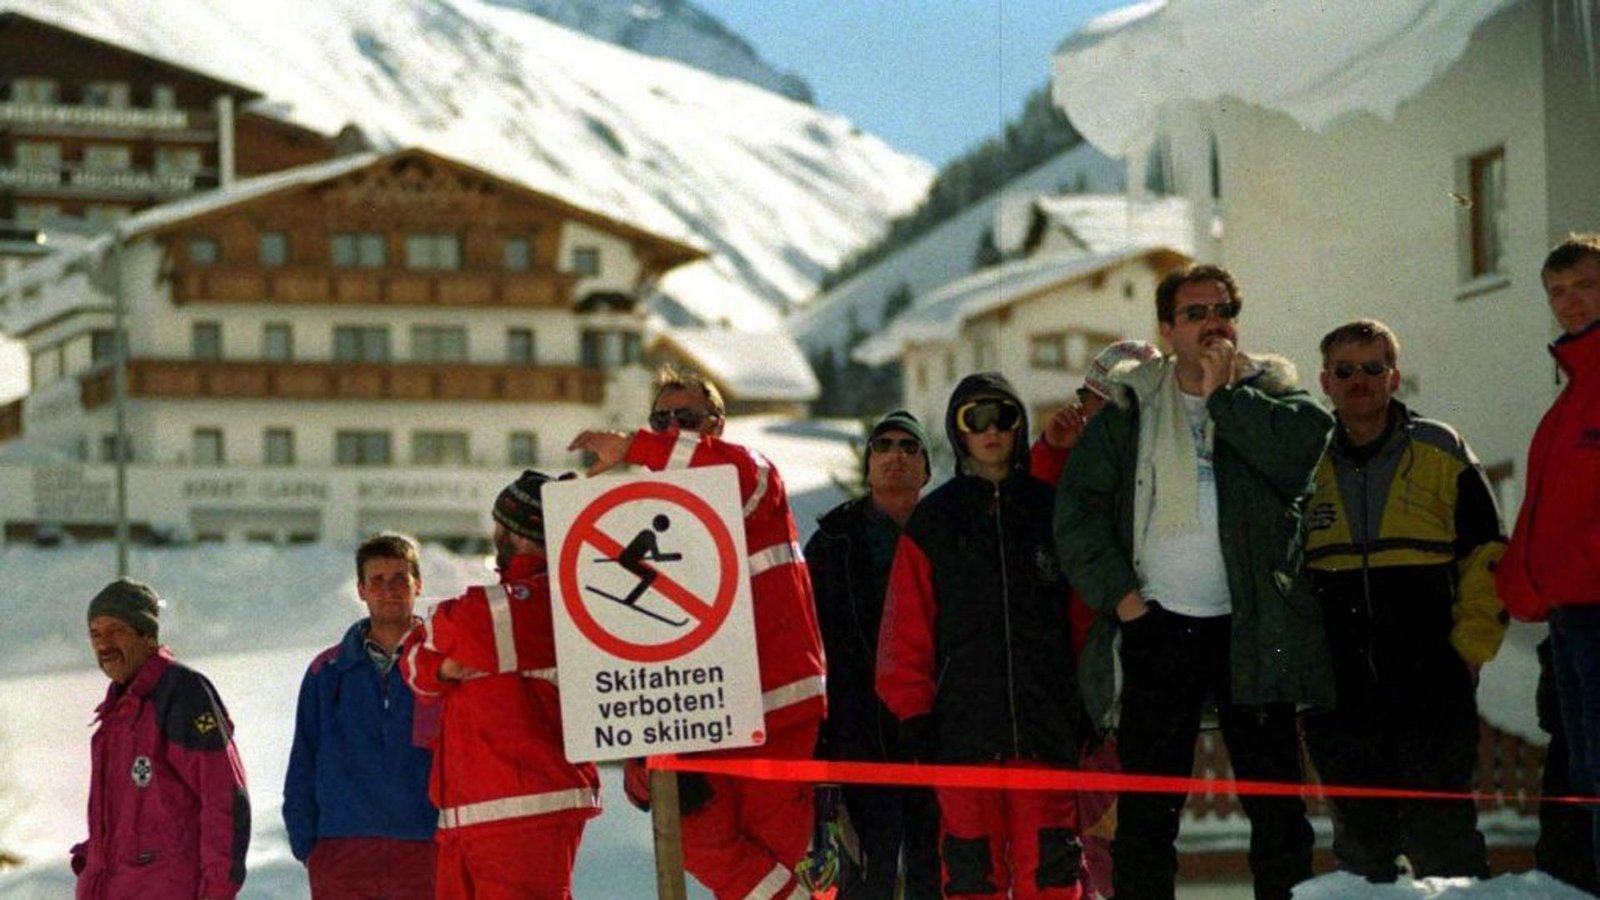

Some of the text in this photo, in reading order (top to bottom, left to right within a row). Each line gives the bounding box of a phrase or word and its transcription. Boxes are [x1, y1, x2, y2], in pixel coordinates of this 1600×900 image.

[595, 666, 723, 693] Skifahren
[599, 687, 724, 719] verboten!
[595, 715, 733, 748] No skiing!
